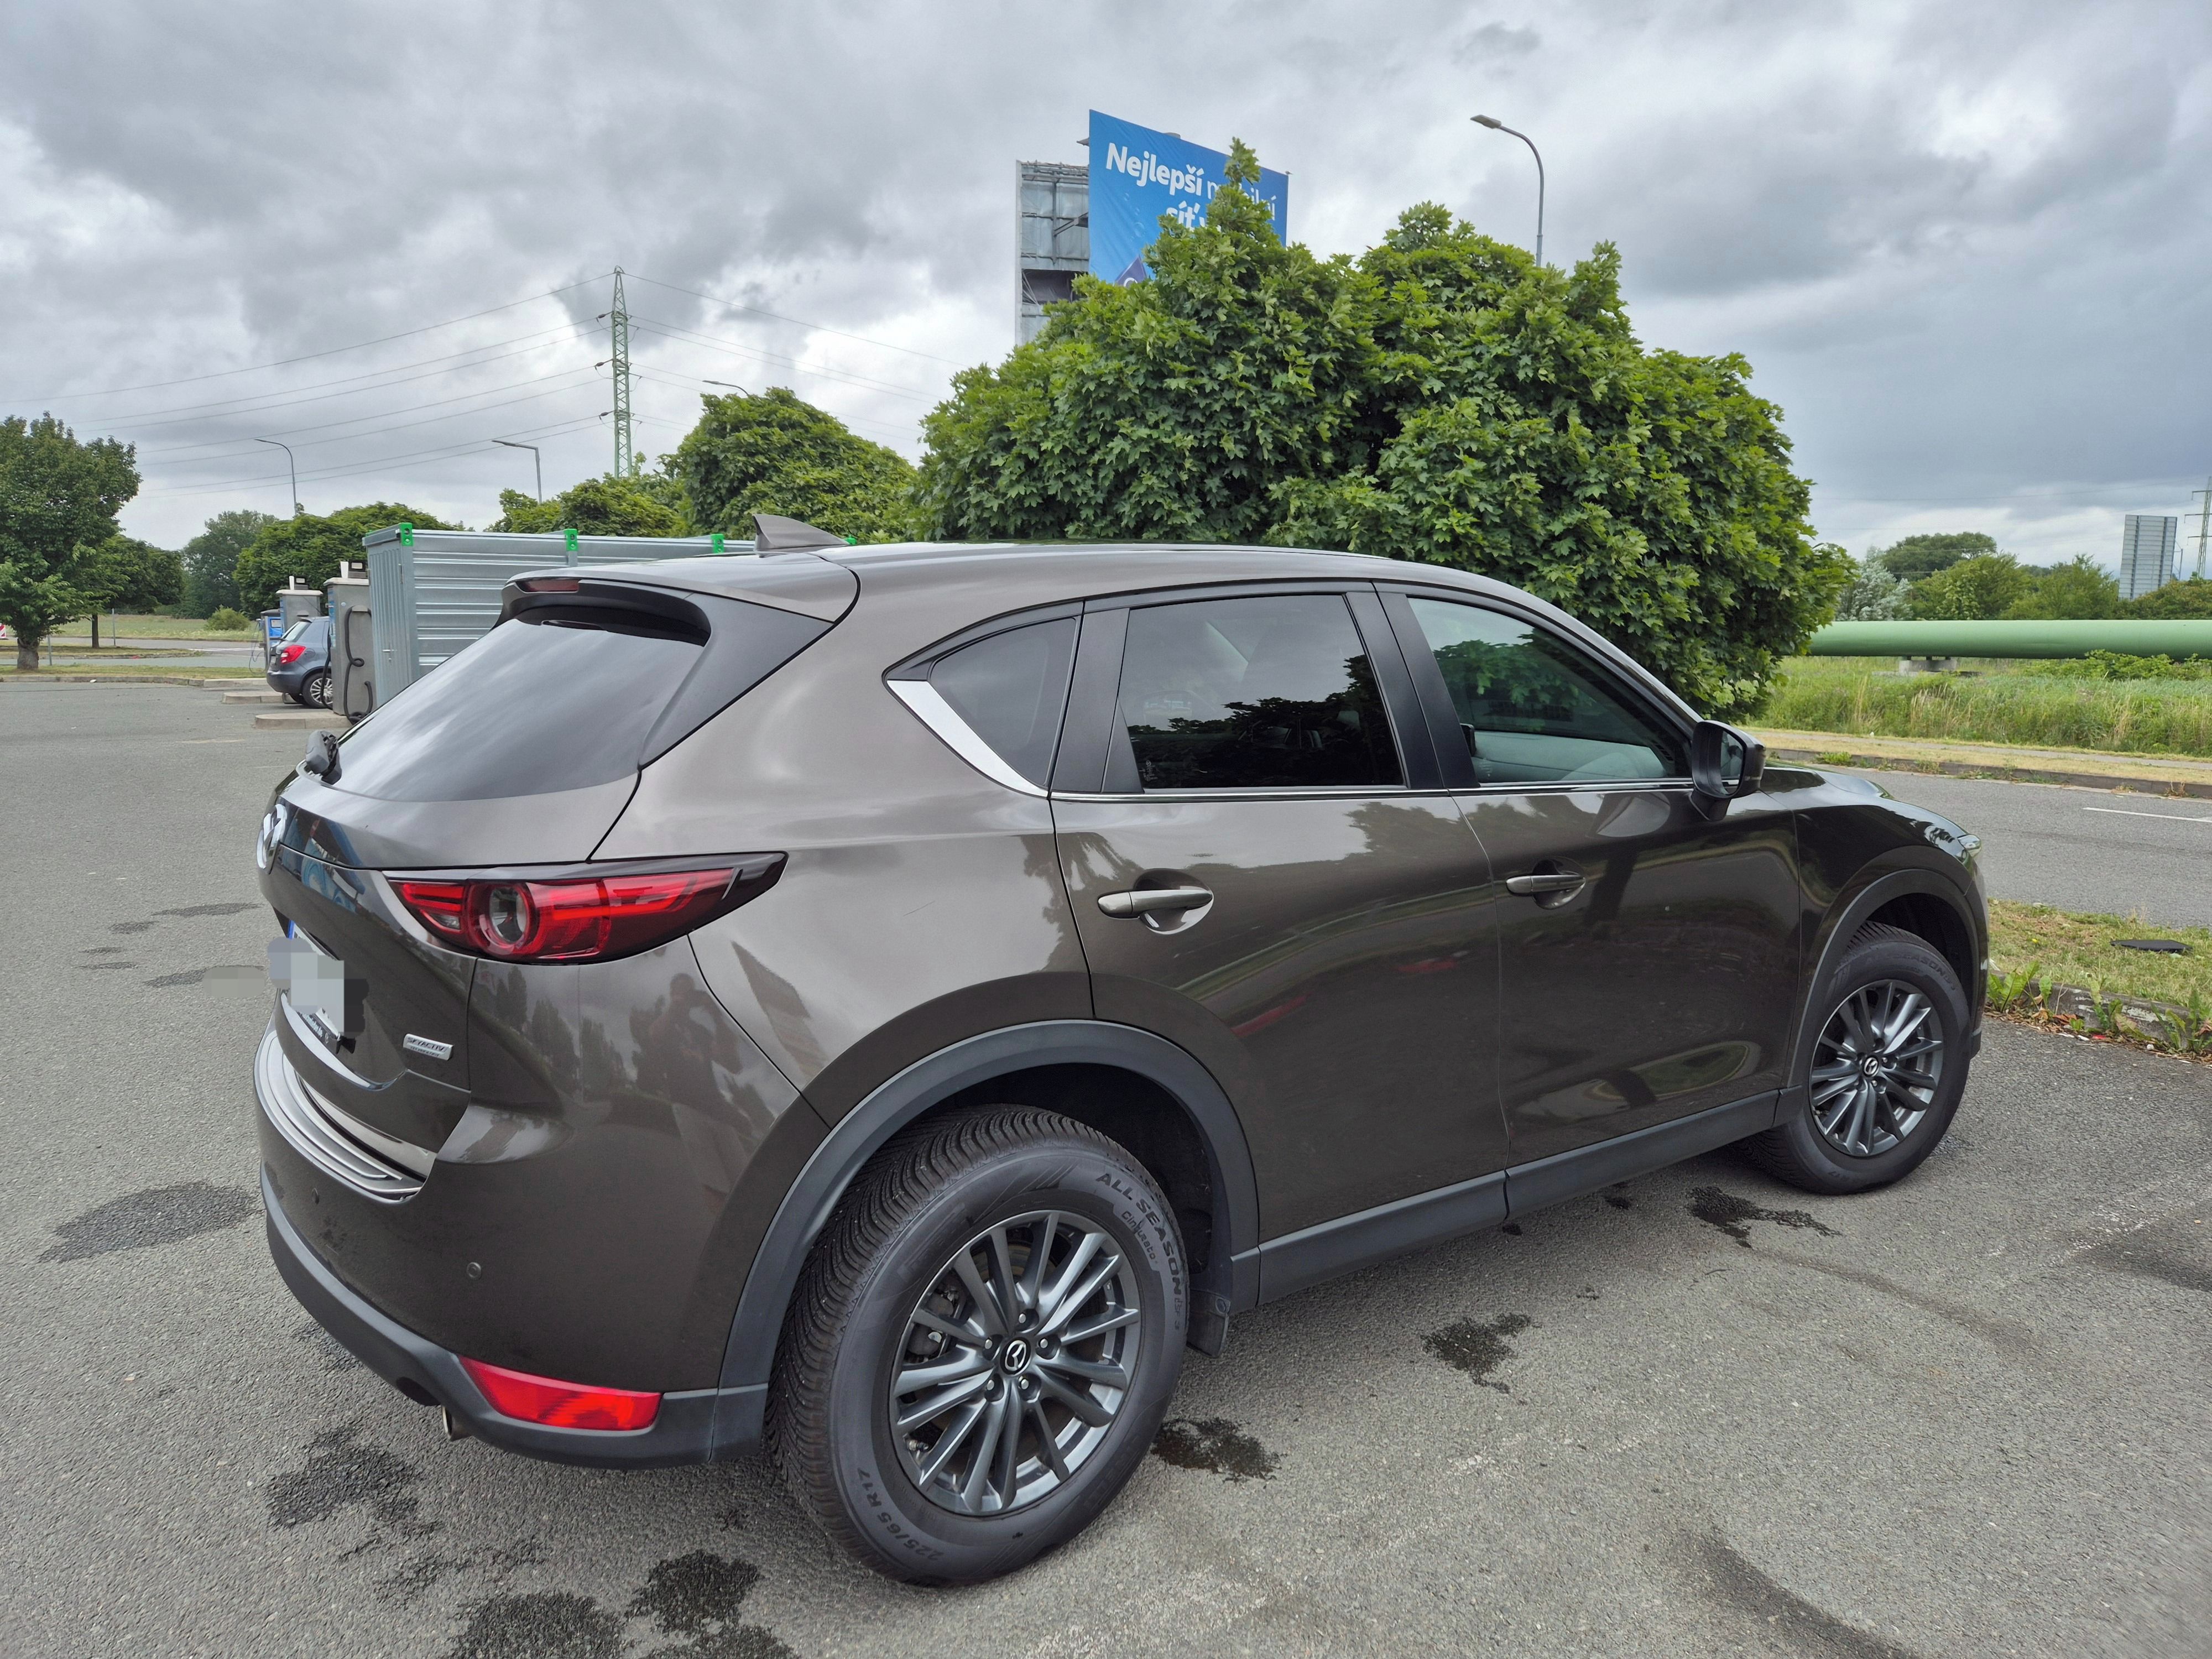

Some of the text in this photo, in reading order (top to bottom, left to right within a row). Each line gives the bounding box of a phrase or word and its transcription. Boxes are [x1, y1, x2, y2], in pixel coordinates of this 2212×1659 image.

[1106, 142, 1204, 196] Nejlepší
[1095, 1173, 1133, 1201] ALL
[1136, 1198, 1182, 1295] SEASON
[858, 1467, 943, 1561] 225/65 R17
